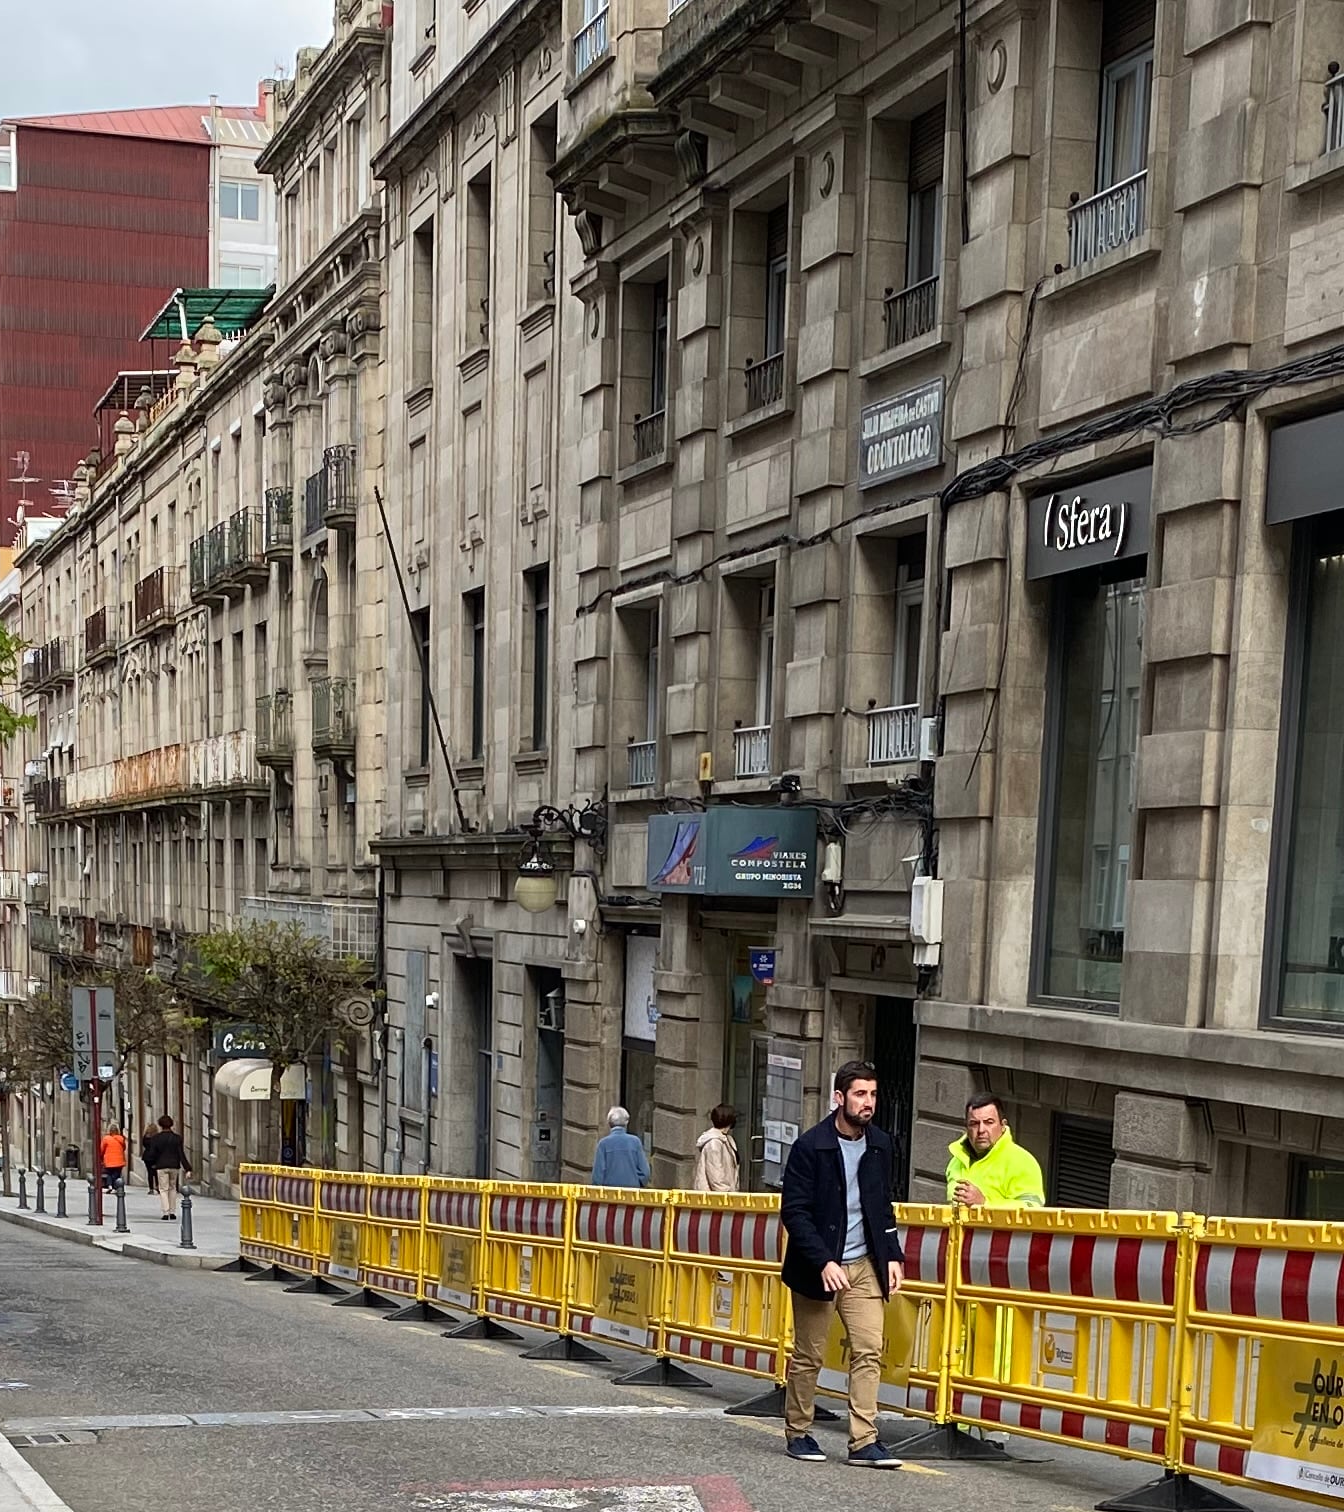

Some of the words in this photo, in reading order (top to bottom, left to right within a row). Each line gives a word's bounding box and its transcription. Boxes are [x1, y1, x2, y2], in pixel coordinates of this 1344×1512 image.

[867, 424, 932, 475] ODONTOLOGO
[731, 859, 807, 868] COMPOSTELA
[735, 873, 761, 881] GRUPO
[1312, 1402, 1329, 1424] EN
